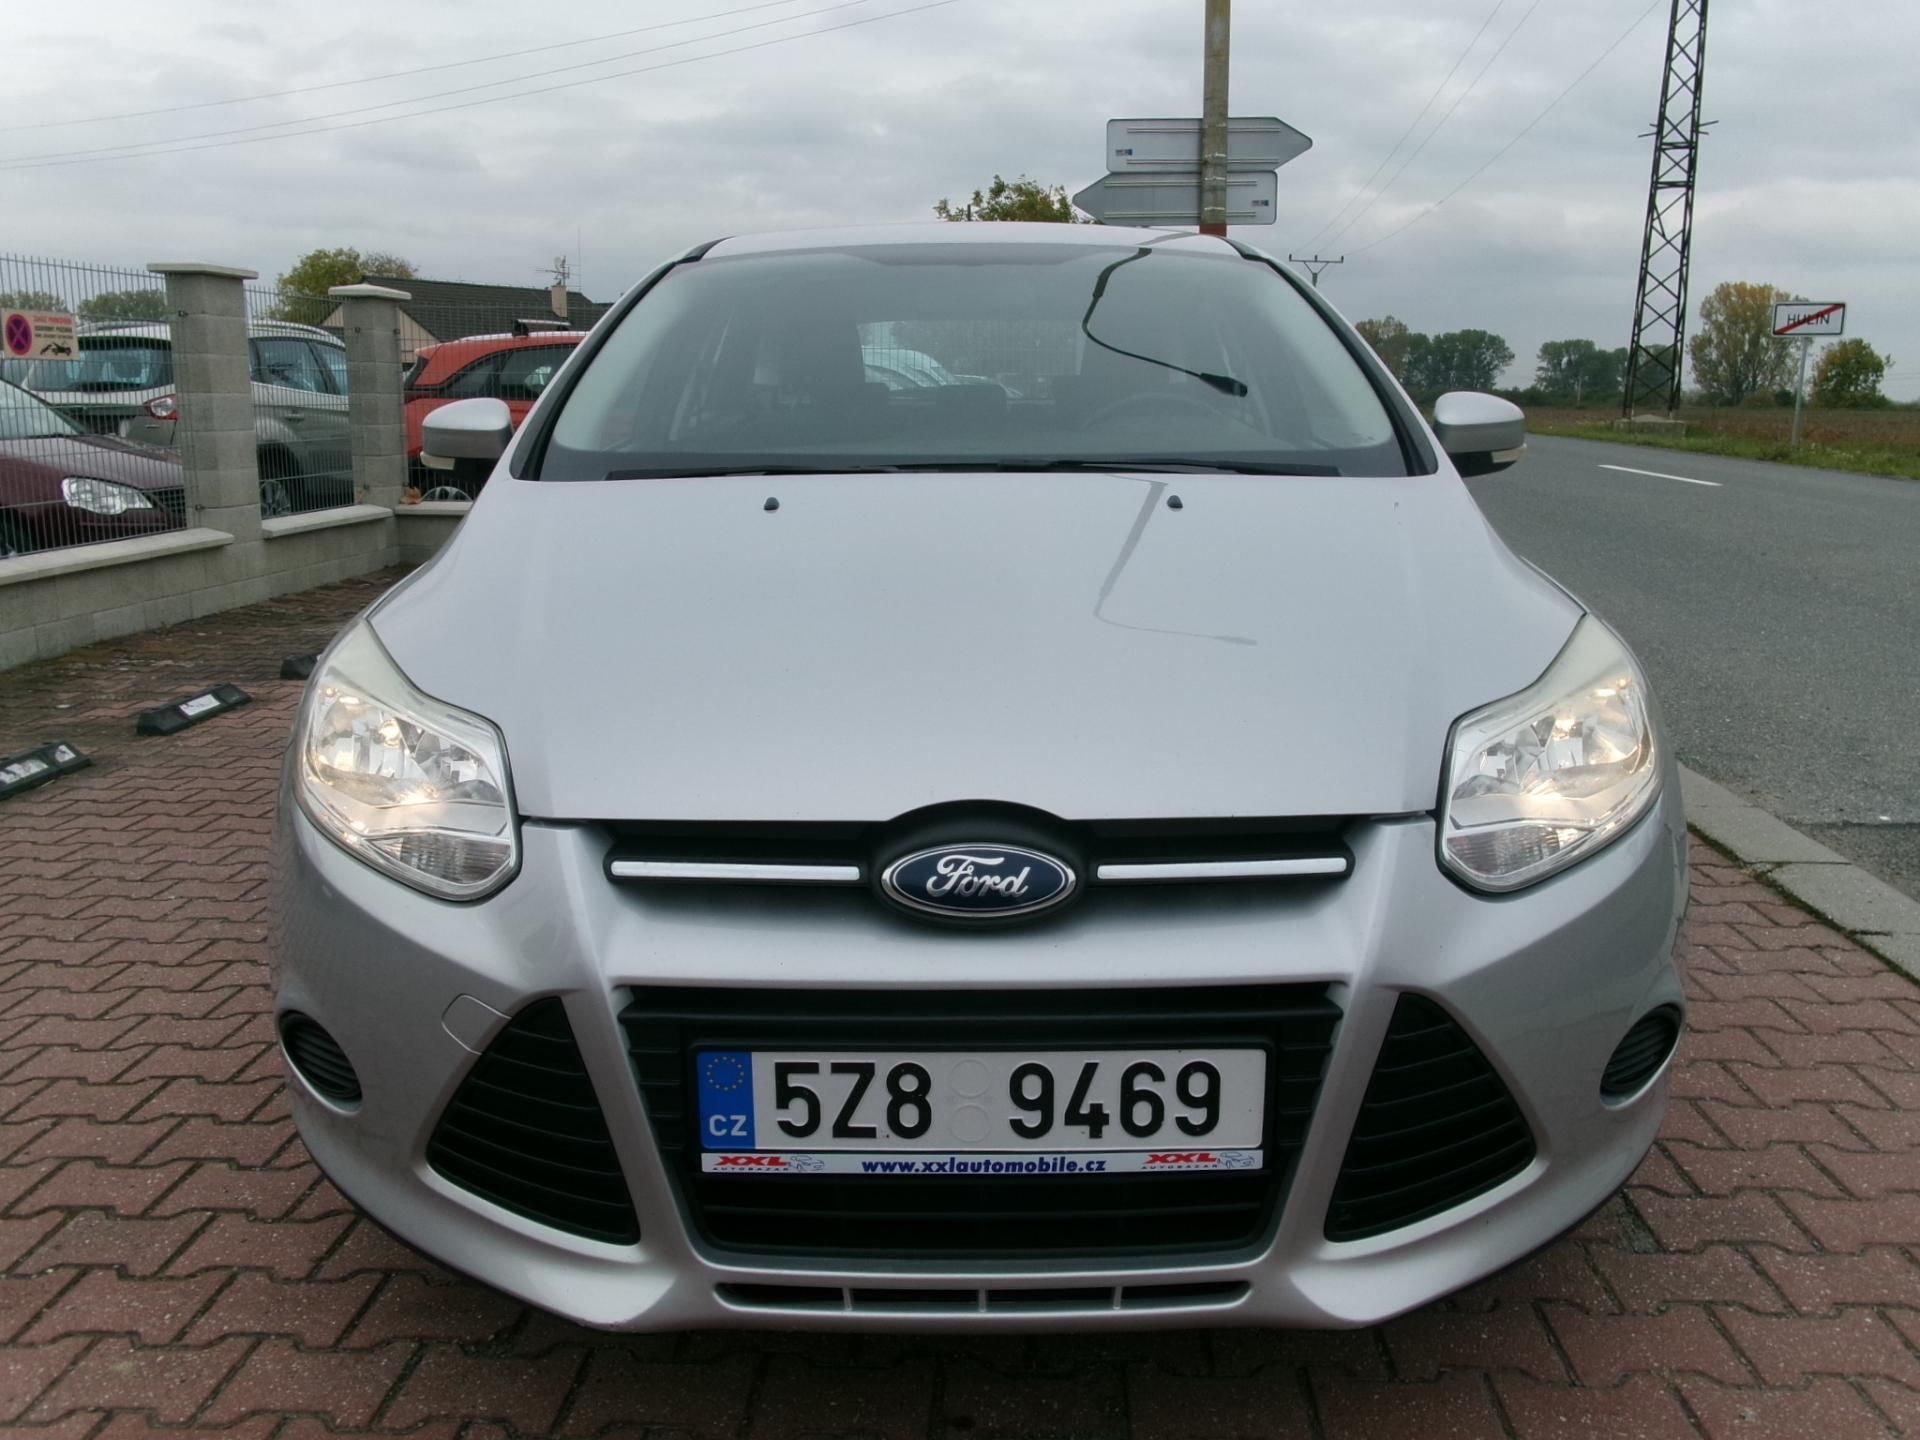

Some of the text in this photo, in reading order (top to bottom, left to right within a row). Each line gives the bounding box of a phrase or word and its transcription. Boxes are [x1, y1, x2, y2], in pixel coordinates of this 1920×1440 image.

[926, 854, 1031, 898] Ford
[774, 1060, 1221, 1140] 5Z8 9469
[709, 1114, 748, 1137] CZ
[713, 1155, 790, 1167] XXL
[862, 1156, 1107, 1173] www.xxlautomobile.cz
[1143, 1153, 1219, 1165] XXL
